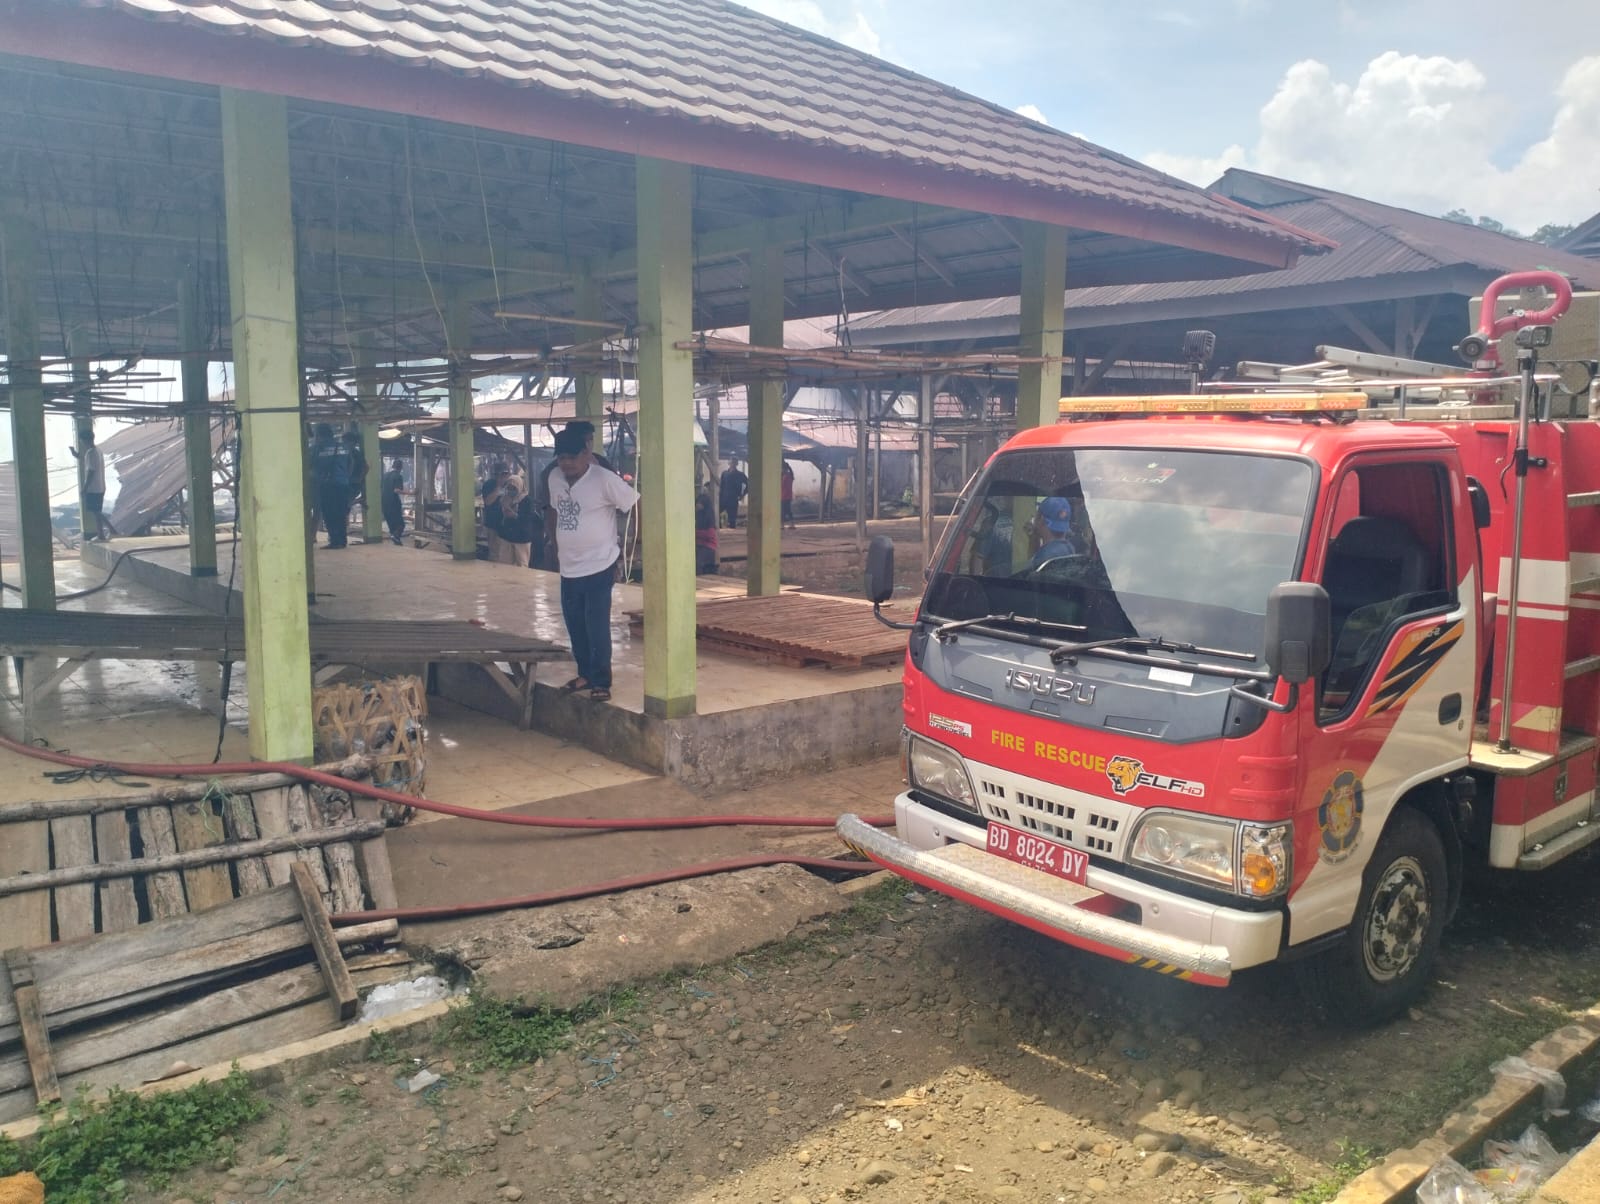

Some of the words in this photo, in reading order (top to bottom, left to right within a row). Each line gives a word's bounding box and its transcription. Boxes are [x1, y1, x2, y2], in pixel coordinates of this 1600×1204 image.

[1005, 668, 1096, 705] ISUZU
[991, 730, 1025, 752] FIRE
[1034, 741, 1106, 774] RESCUE
[1136, 772, 1187, 790] ELF
[989, 825, 1009, 851] BD
[1016, 835, 1056, 868] 8024
[1061, 849, 1084, 878] DY
